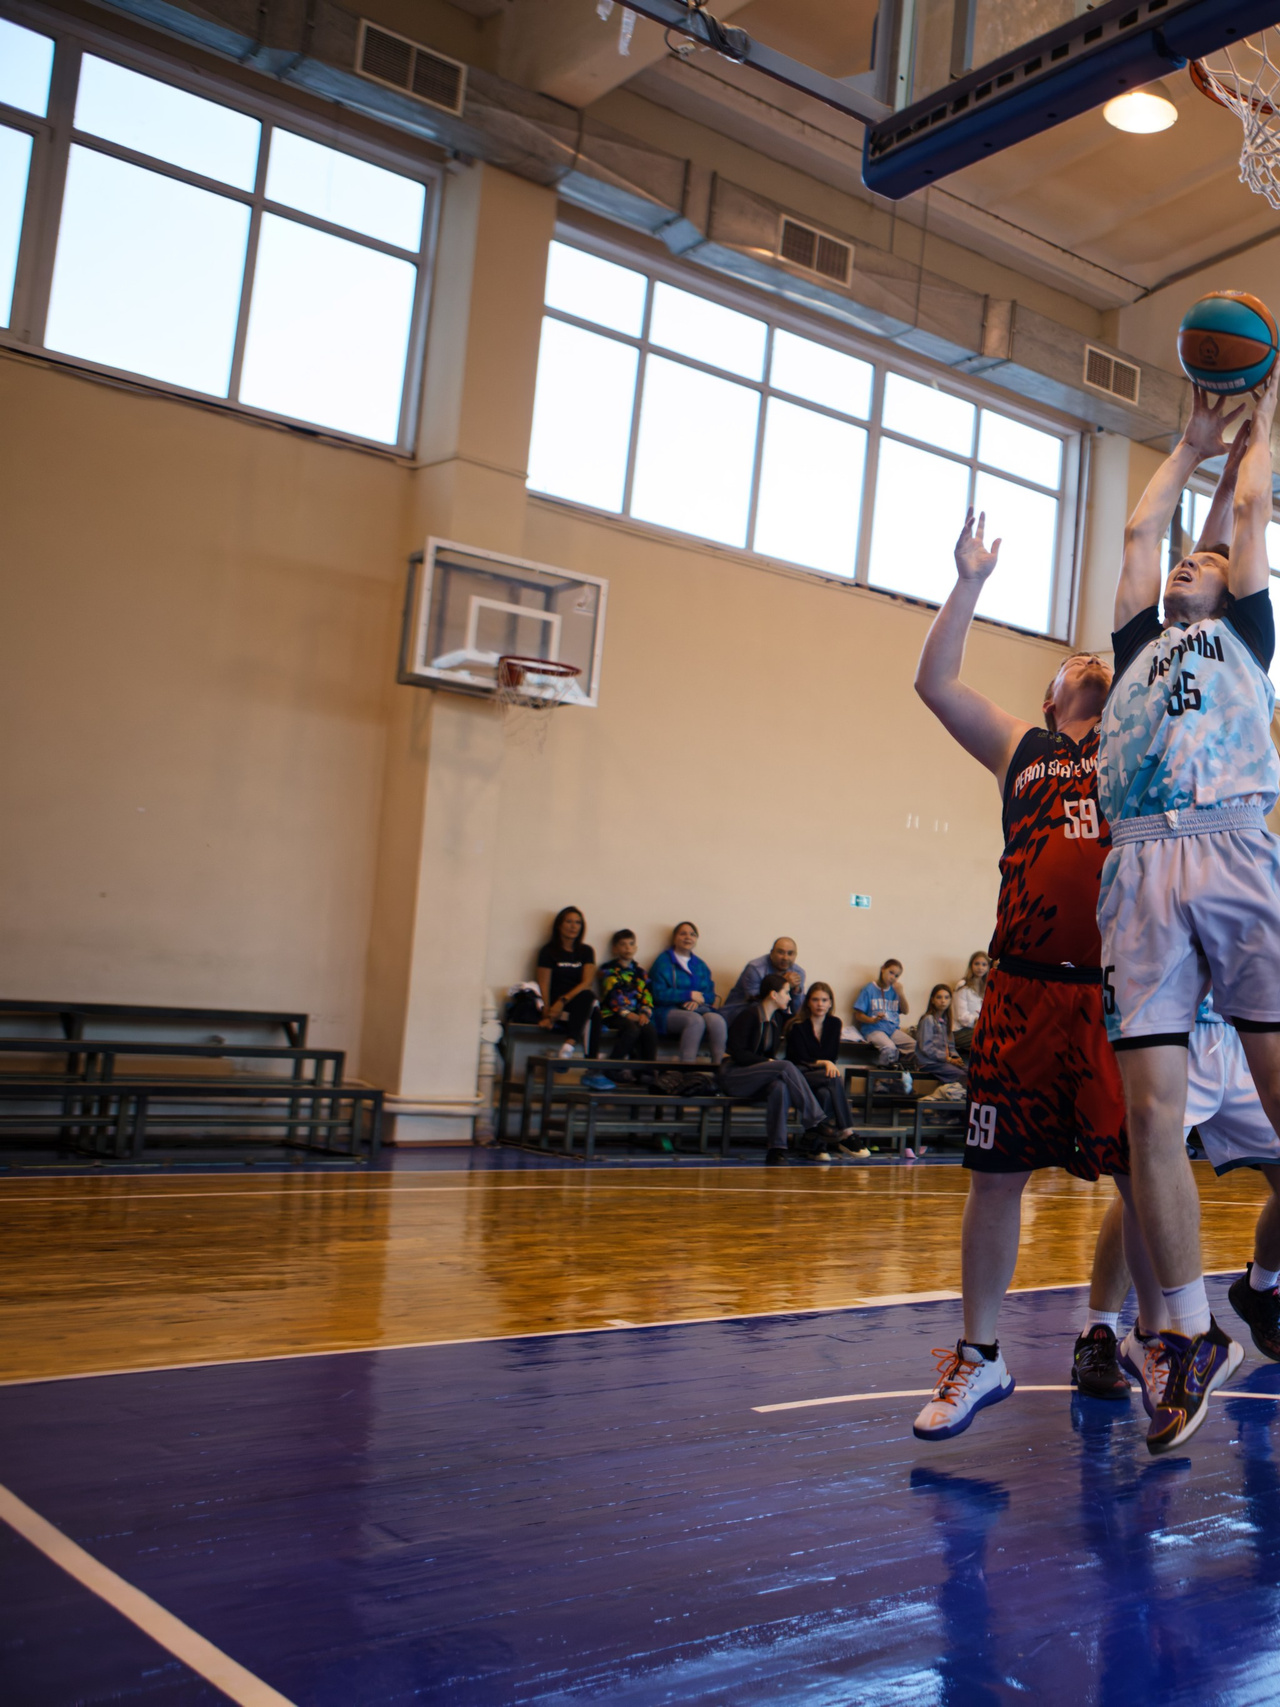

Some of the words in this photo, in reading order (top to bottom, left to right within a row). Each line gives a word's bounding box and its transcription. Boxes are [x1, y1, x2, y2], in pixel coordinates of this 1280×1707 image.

[1014, 762, 1046, 797] PERM
[1048, 759, 1082, 778] STATE
[1063, 798, 1100, 839] 59
[966, 1101, 998, 1150] 59
